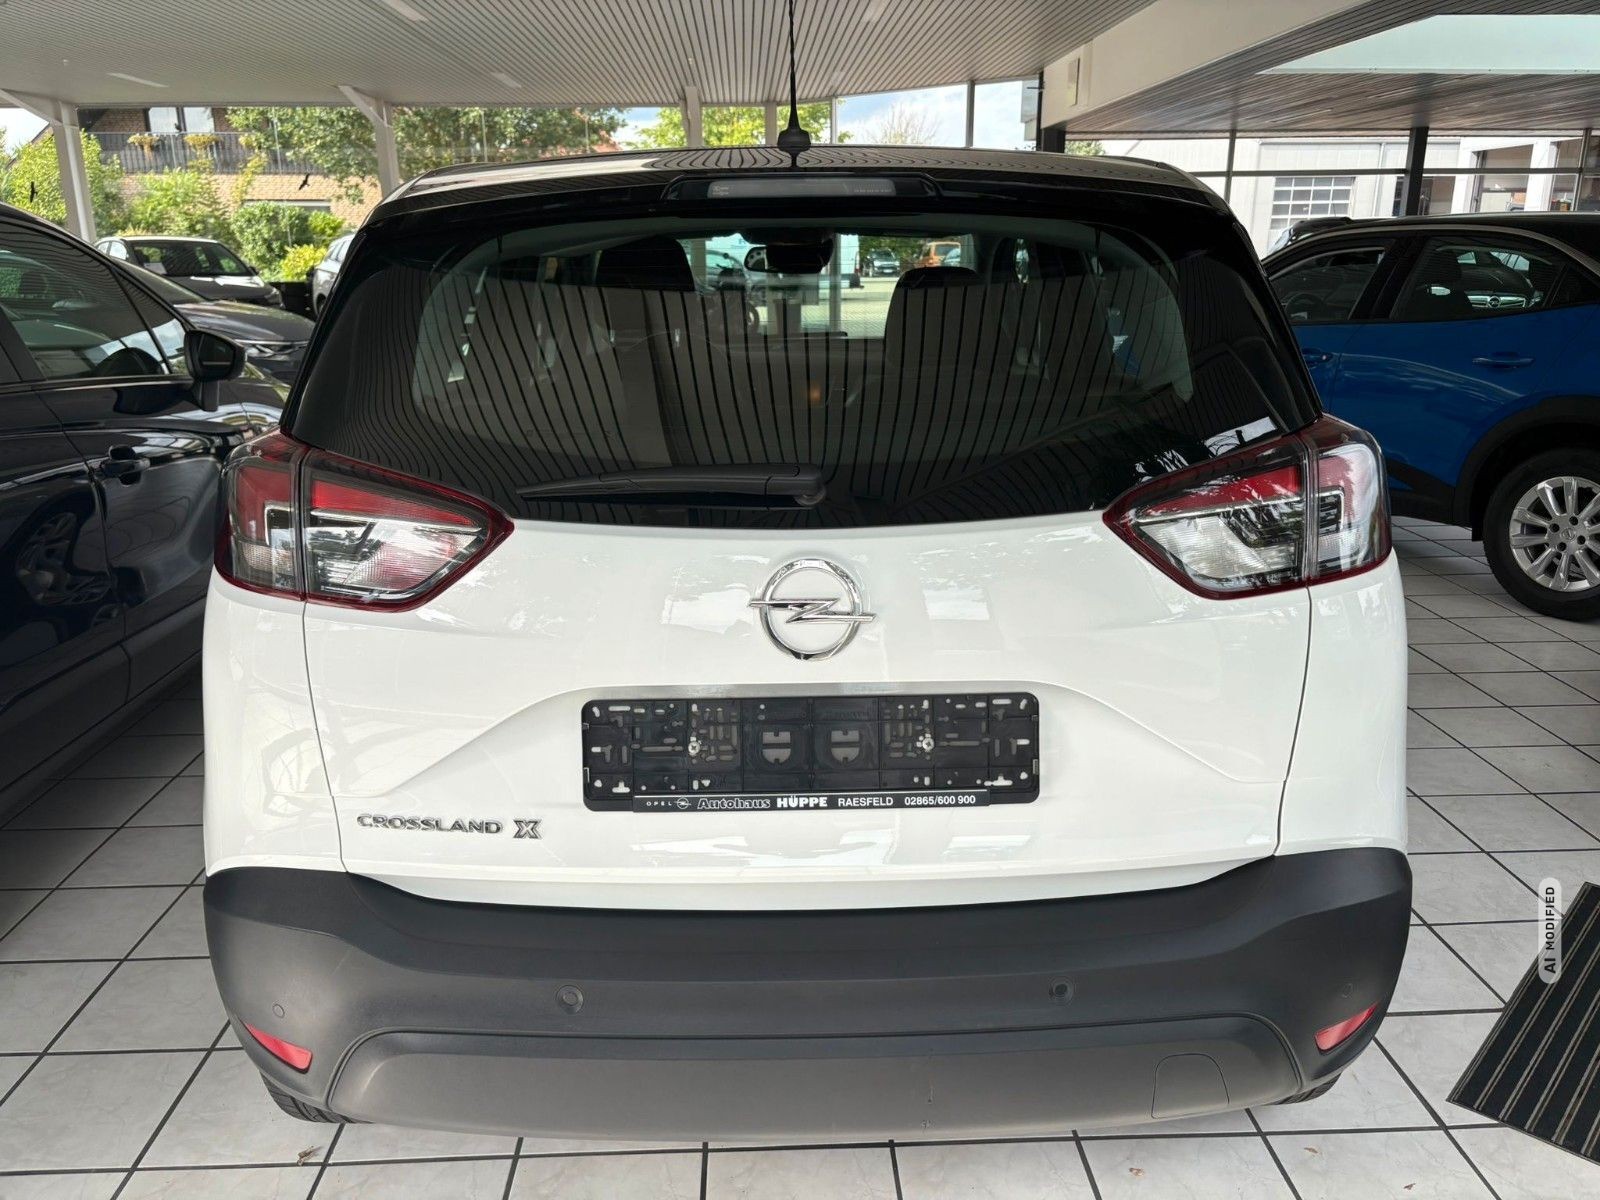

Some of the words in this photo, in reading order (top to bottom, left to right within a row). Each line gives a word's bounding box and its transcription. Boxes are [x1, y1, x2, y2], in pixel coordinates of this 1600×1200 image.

[697, 797, 771, 810] Autohaus
[776, 795, 828, 808] HÜPPE
[838, 797, 894, 807] RAESFELD
[904, 795, 956, 806] 02865/600
[957, 795, 976, 805] 900
[356, 813, 503, 834] CROSSLAND
[512, 818, 542, 839] X
